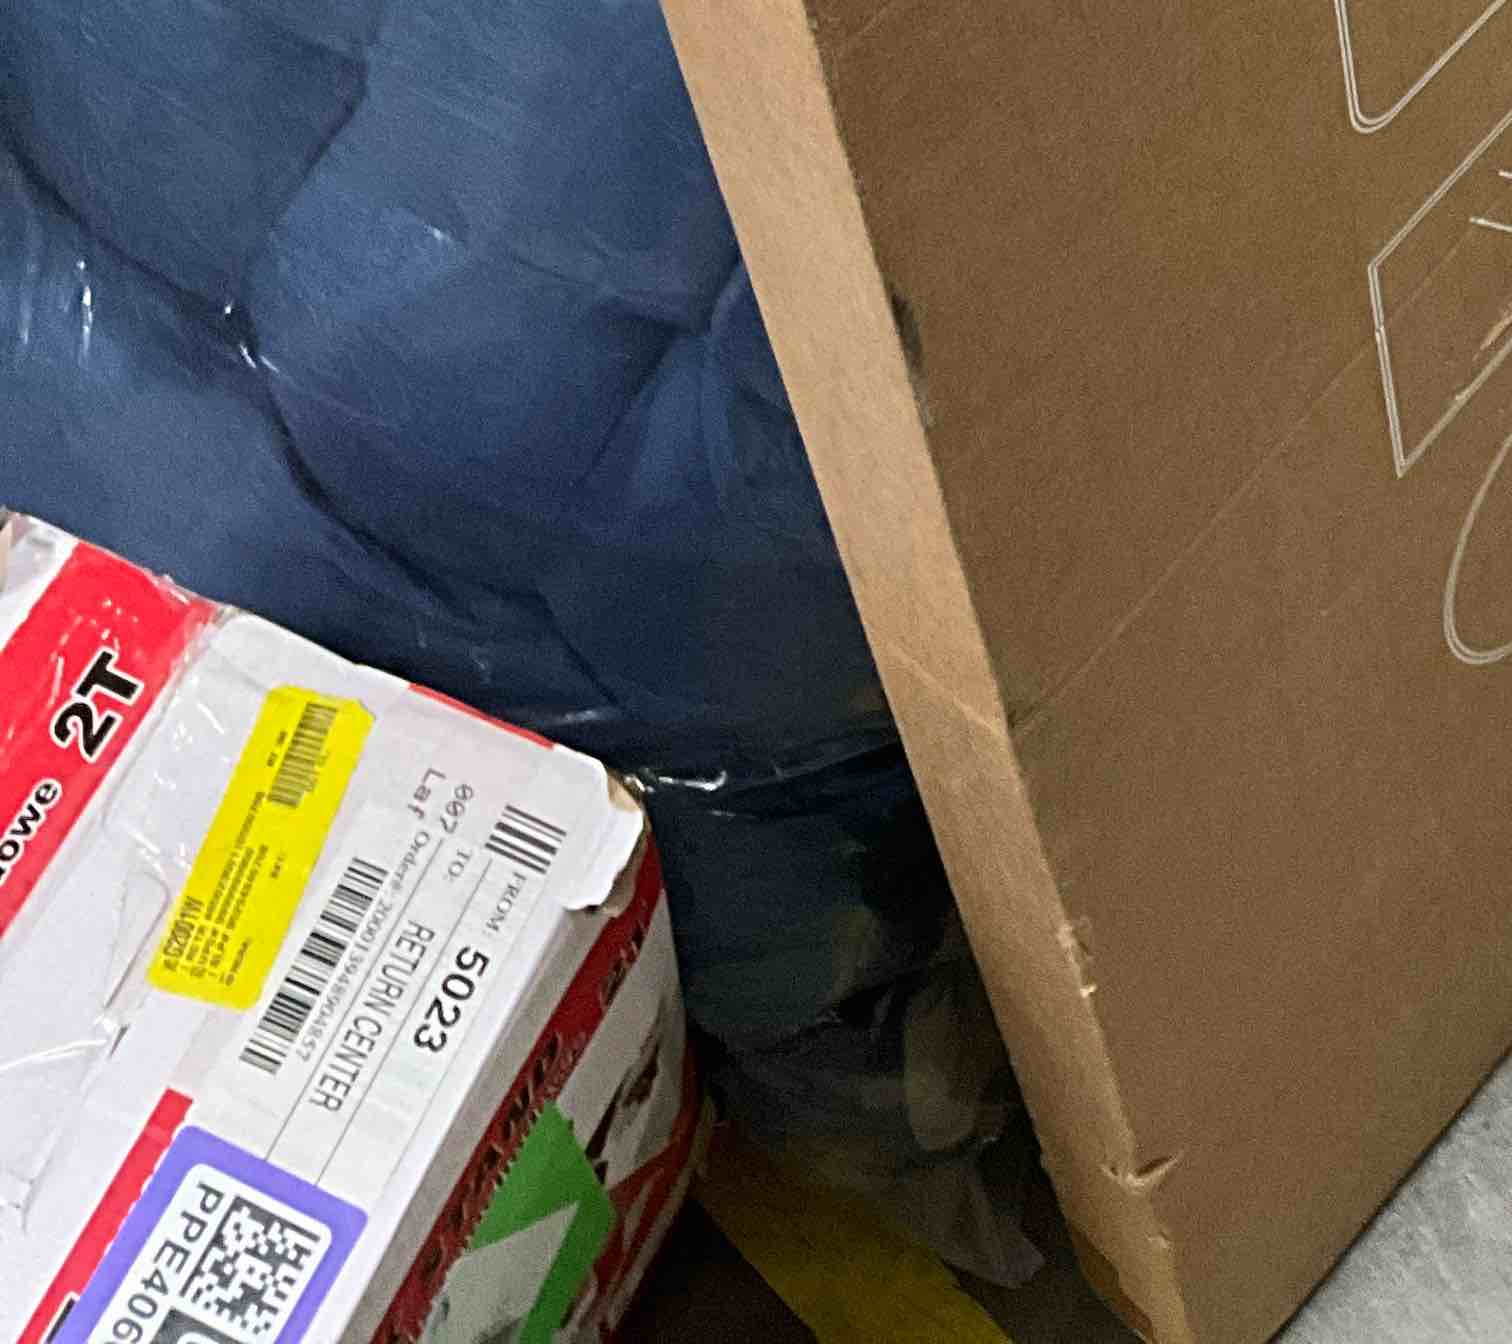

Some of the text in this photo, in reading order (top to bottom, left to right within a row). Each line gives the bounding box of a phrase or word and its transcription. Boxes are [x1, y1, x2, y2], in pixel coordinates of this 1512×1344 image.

[0, 649, 141, 878] owe 2T
[433, 780, 477, 836] 007
[362, 917, 436, 1020] RETURN
[409, 942, 492, 1059] 5023
[308, 1009, 385, 1118] CENTER
[104, 1182, 225, 1344] PPE406
